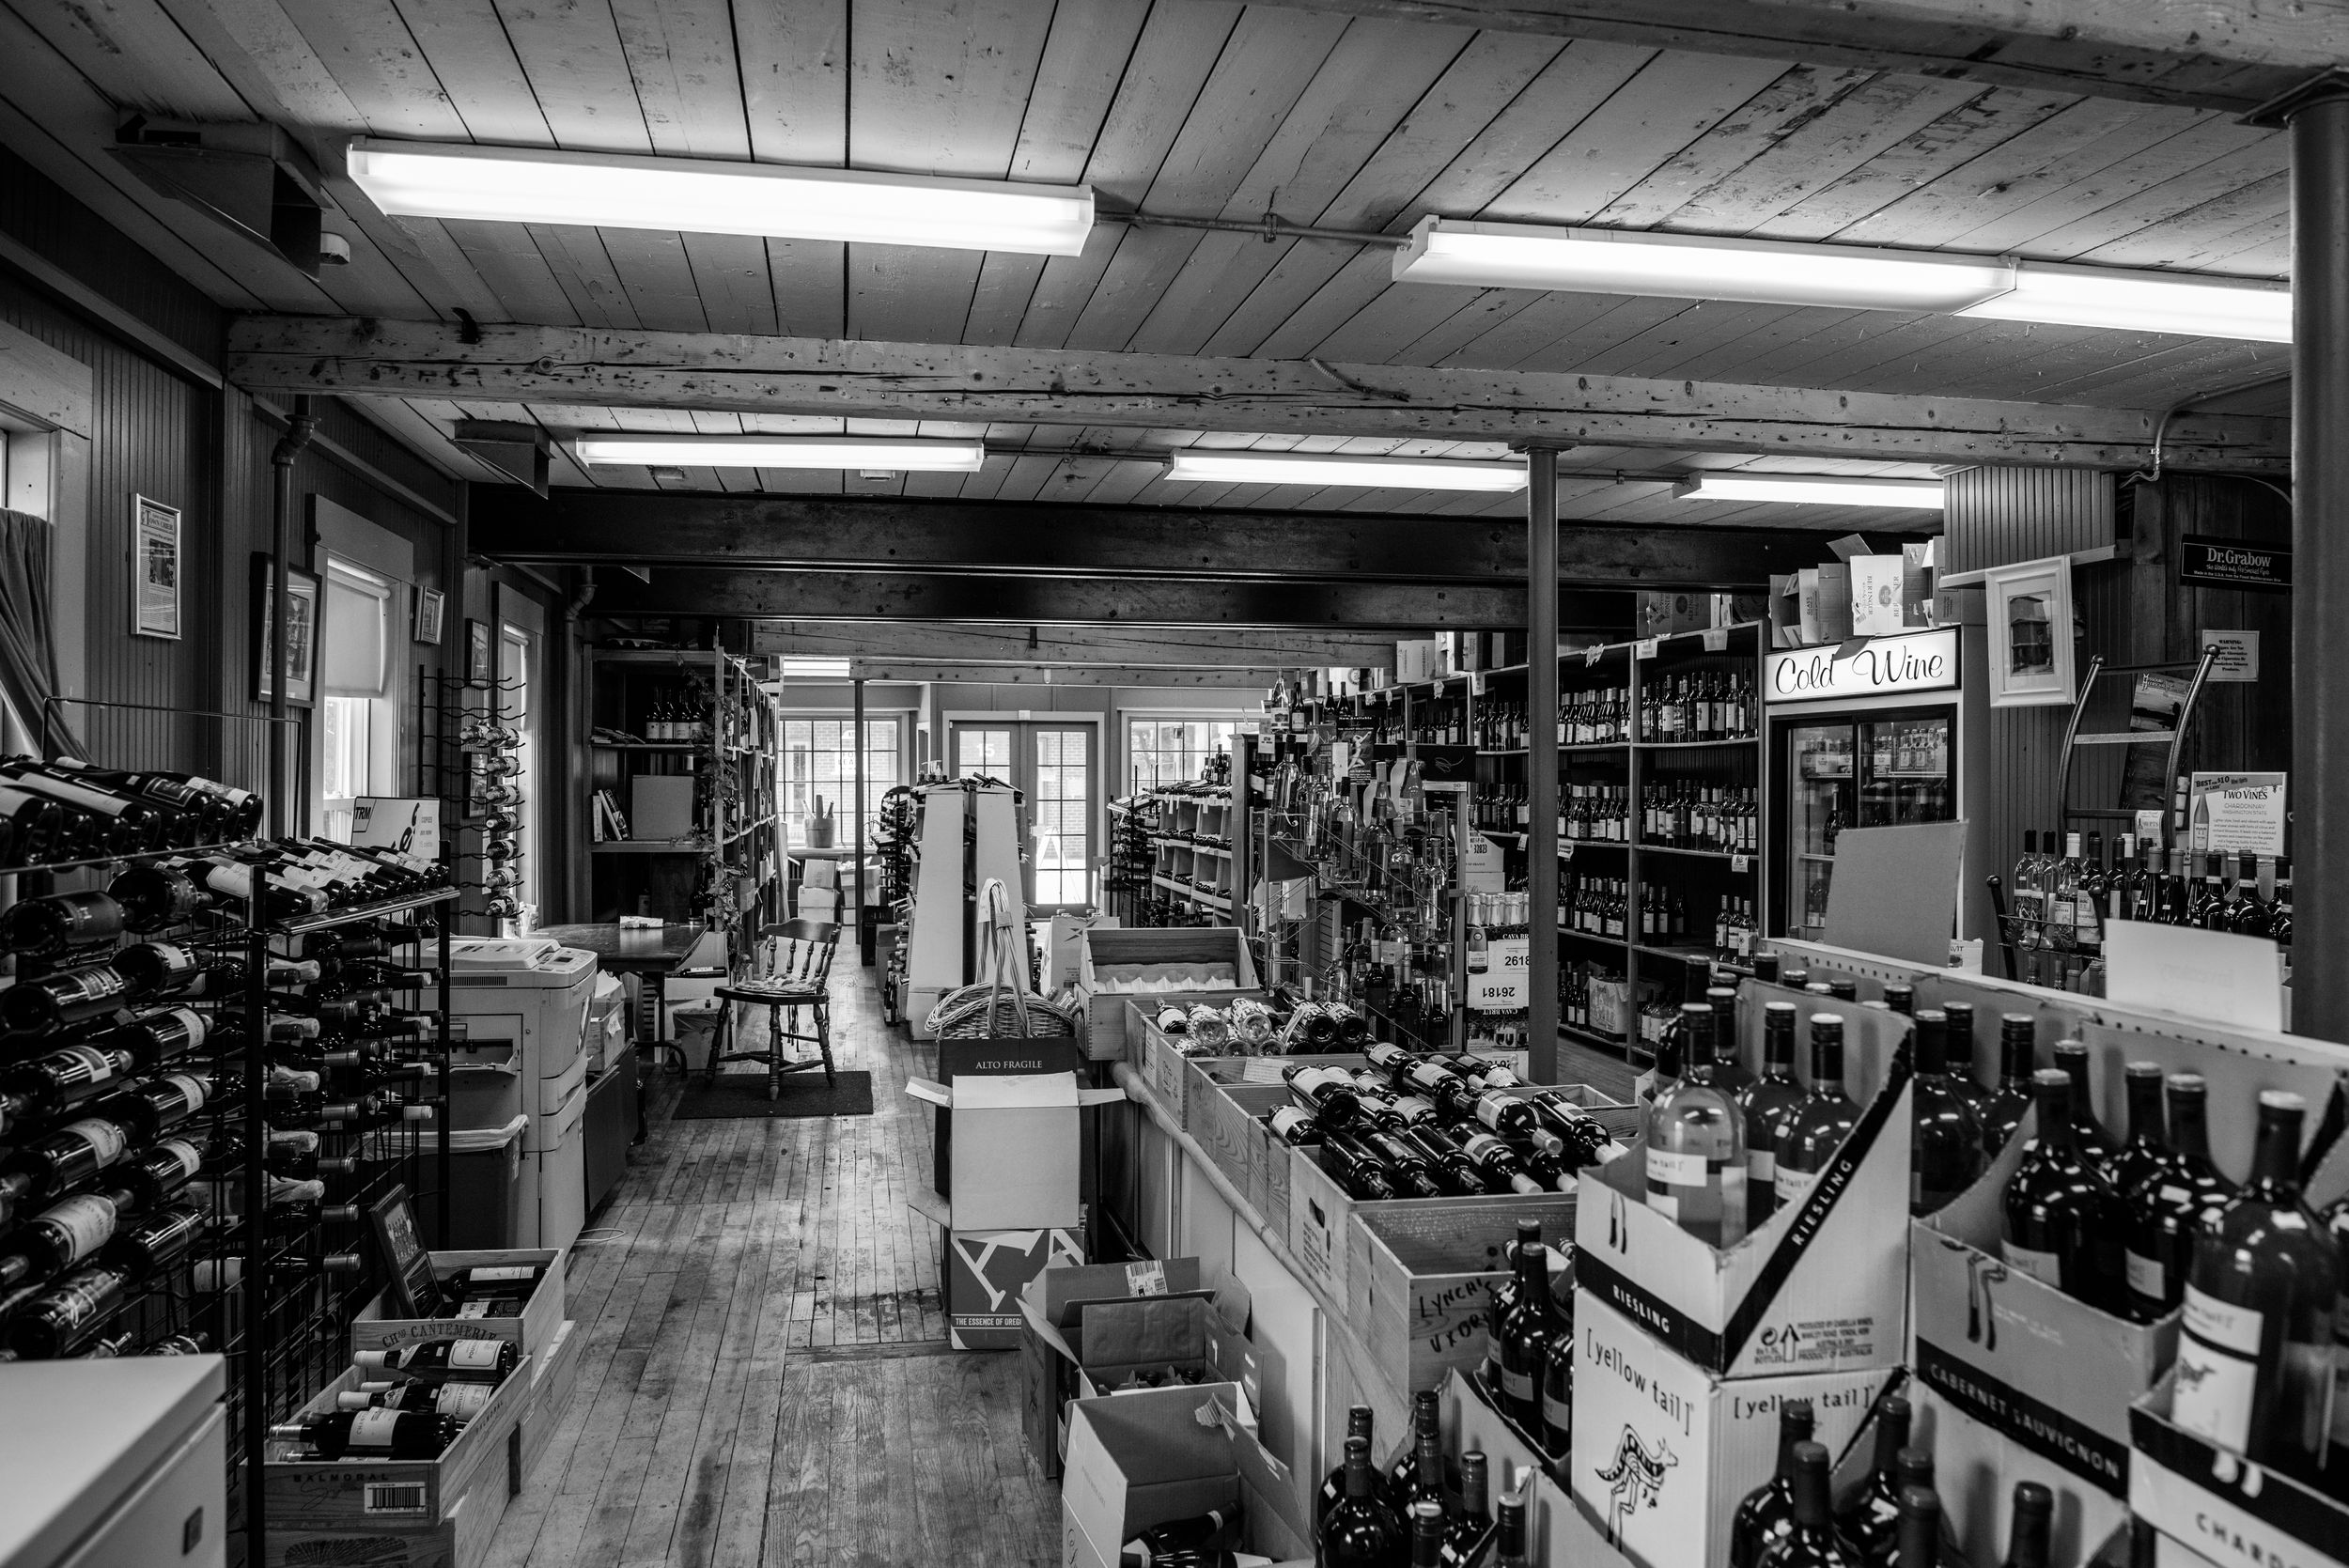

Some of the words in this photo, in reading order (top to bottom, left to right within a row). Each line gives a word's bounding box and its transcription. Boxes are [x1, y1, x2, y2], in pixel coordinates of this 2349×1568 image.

[1776, 653, 1835, 695] Cold
[1852, 644, 1943, 686] Wine
[2223, 790, 2242, 800] TWO
[2243, 790, 2267, 800] VINES
[1505, 955, 1530, 967] 2618
[1483, 986, 1516, 998] 26181
[975, 1061, 1001, 1069] ALTO
[1003, 1060, 1043, 1069] FRAGILE
[1791, 1159, 1853, 1247] RIESLING
[1612, 1283, 1671, 1334] RIESLING
[956, 1317, 968, 1326] THE
[969, 1317, 994, 1326] ESSENCE
[995, 1317, 1003, 1326] OF
[1004, 1317, 1021, 1326] OREG
[411, 1323, 497, 1341] CANTEMERLE
[1930, 1362, 2007, 1416] CABERNET
[2013, 1407, 2120, 1480] SAUVIGNON
[293, 1472, 390, 1483] BALMORAL
[2196, 1513, 2301, 1568] CHARD
